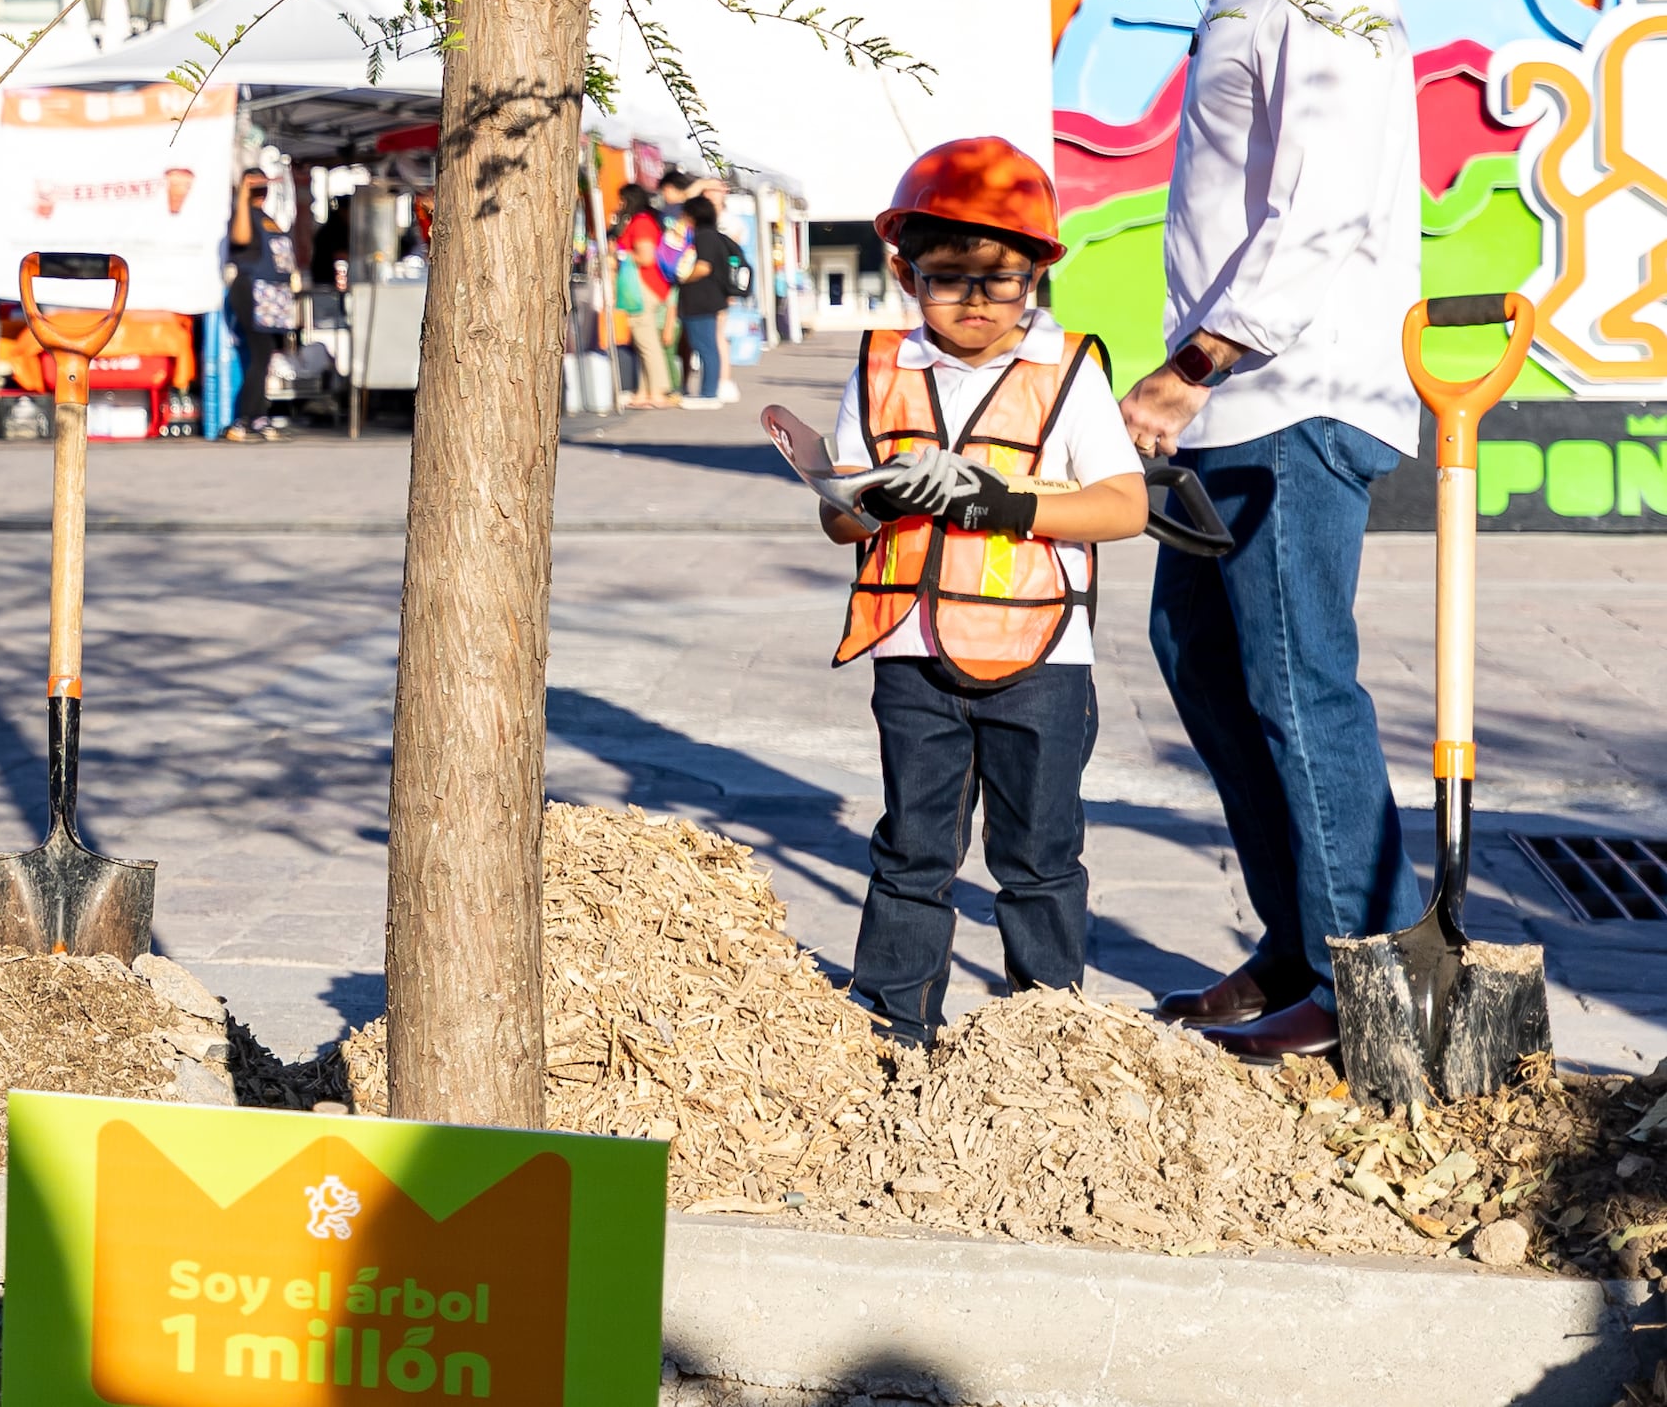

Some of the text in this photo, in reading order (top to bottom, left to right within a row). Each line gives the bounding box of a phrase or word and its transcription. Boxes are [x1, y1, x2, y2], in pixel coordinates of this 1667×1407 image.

[169, 1259, 489, 1323] Soy el árbol
[161, 1314, 490, 1398] 1 millón
